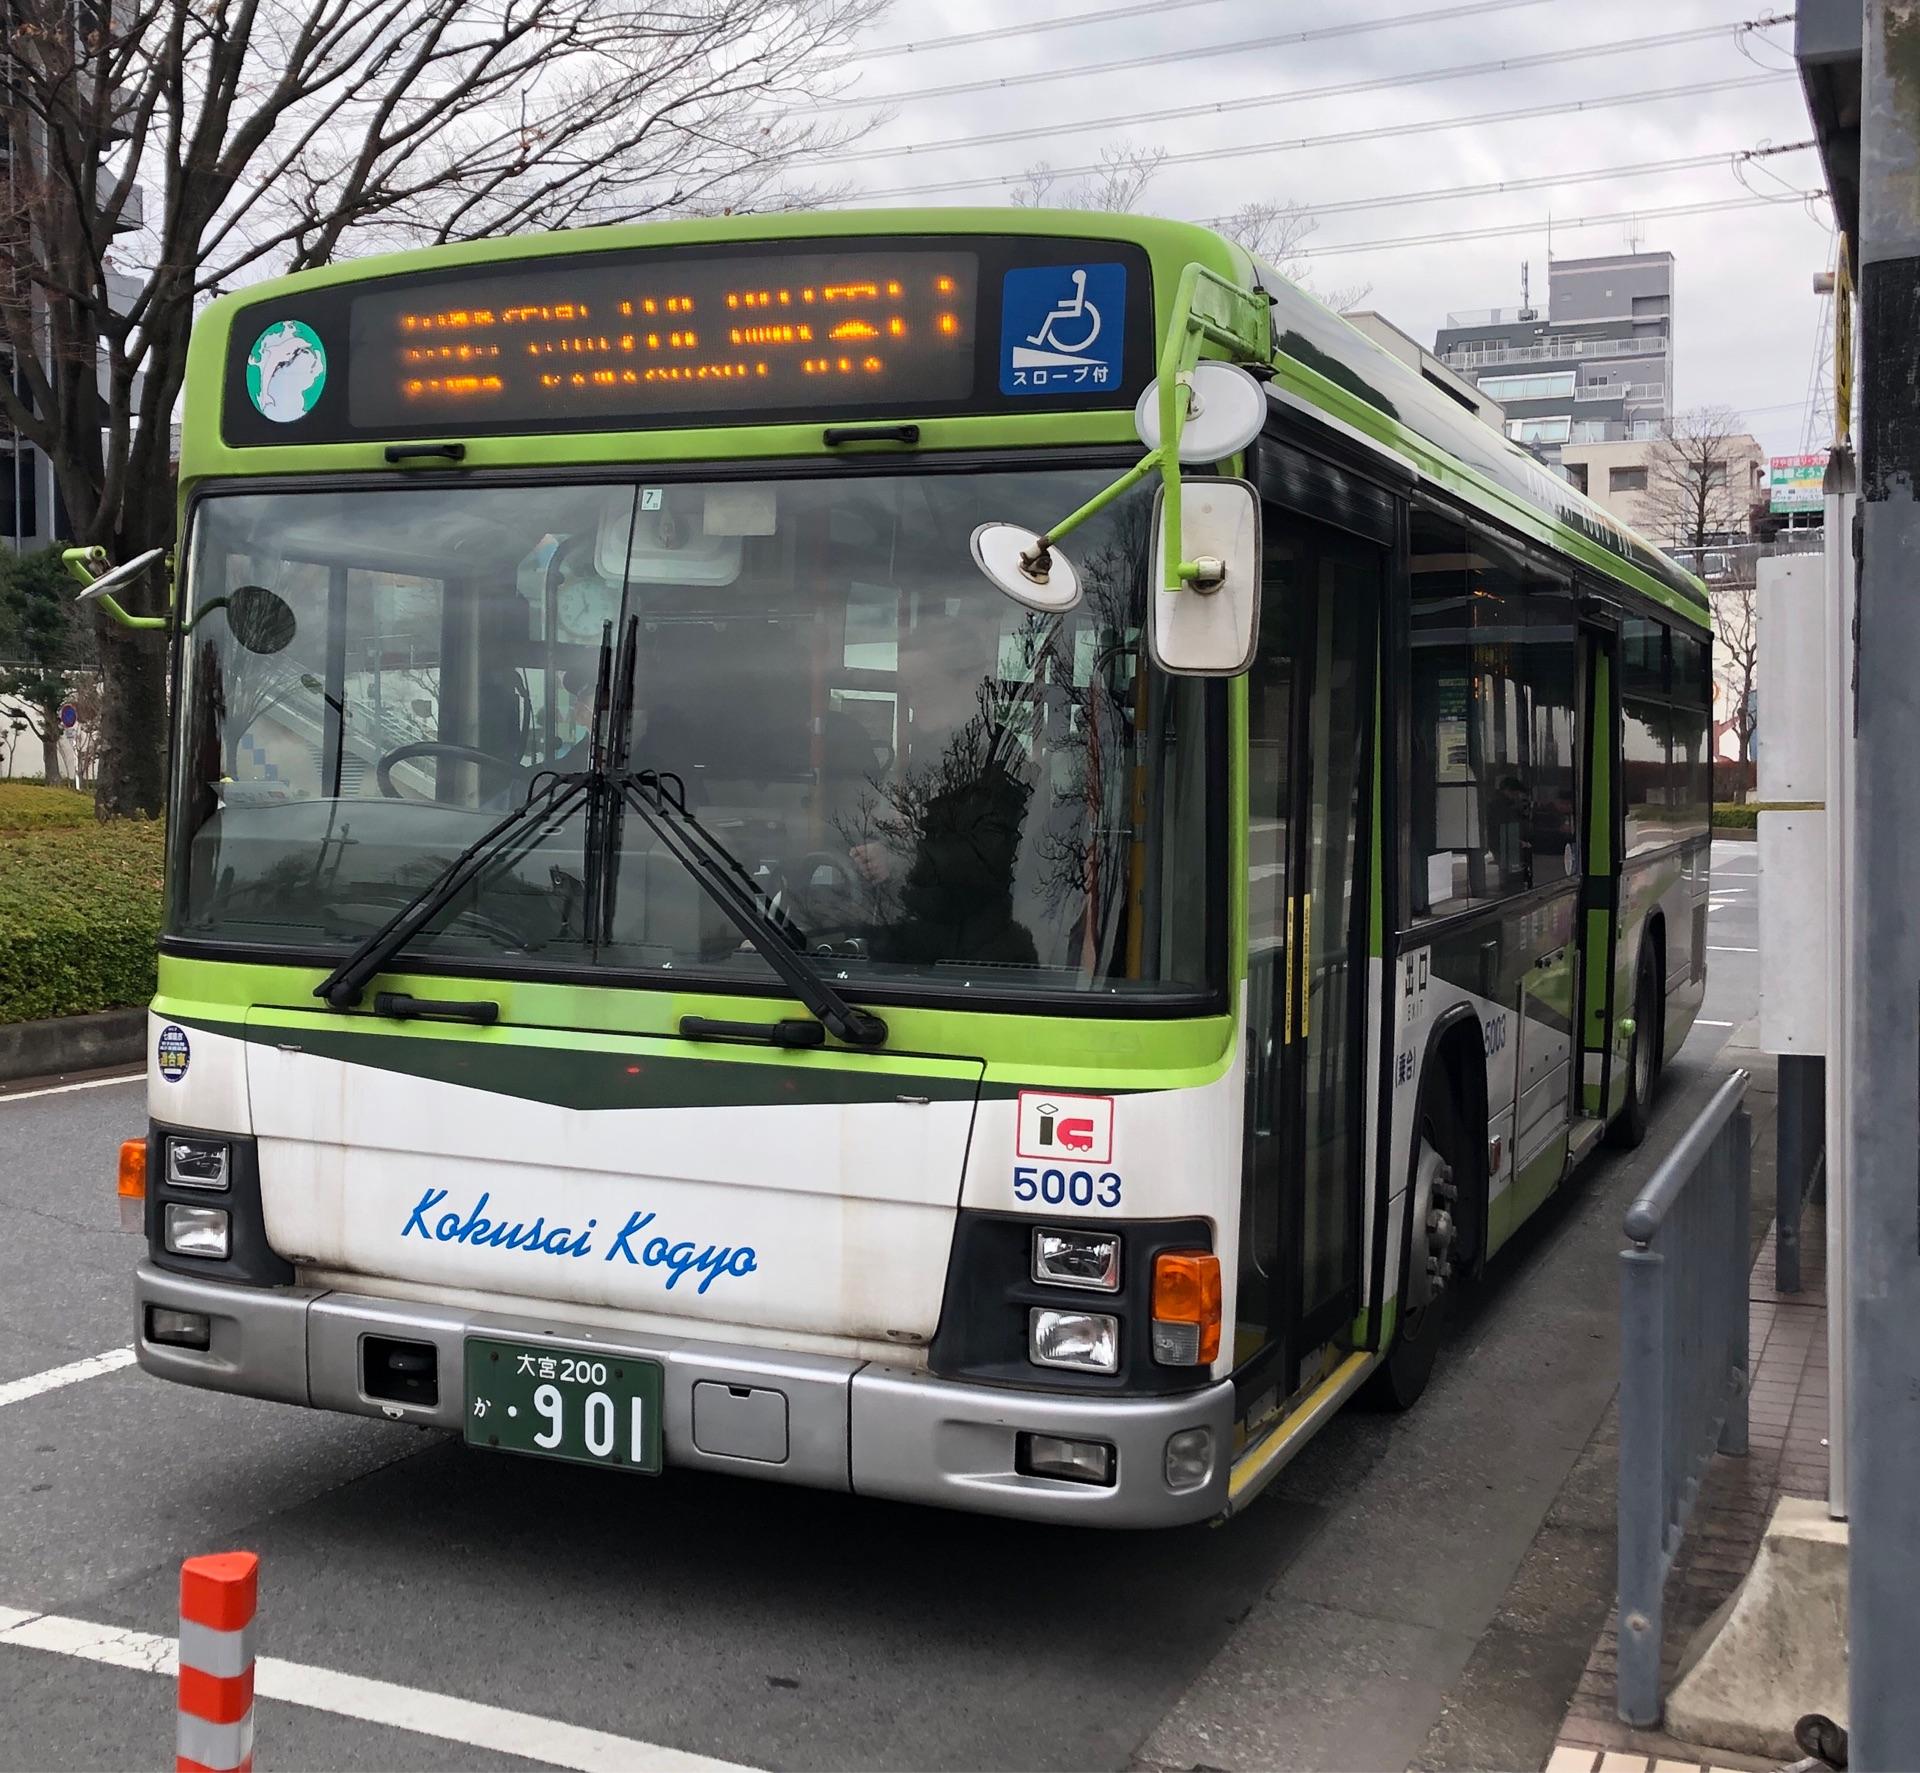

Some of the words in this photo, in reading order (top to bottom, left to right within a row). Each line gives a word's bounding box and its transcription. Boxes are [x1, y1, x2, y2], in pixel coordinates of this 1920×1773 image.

[1012, 366, 1109, 386] スロープ付
[646, 492, 654, 504] 7
[1405, 951, 1427, 998] 出口
[1407, 999, 1424, 1022] EXIT
[1484, 1014, 1506, 1058] 5003
[1014, 1167, 1122, 1208] 5003
[401, 1187, 597, 1258] Kokusai
[605, 1210, 758, 1295] Kogyo
[473, 1396, 492, 1418] か
